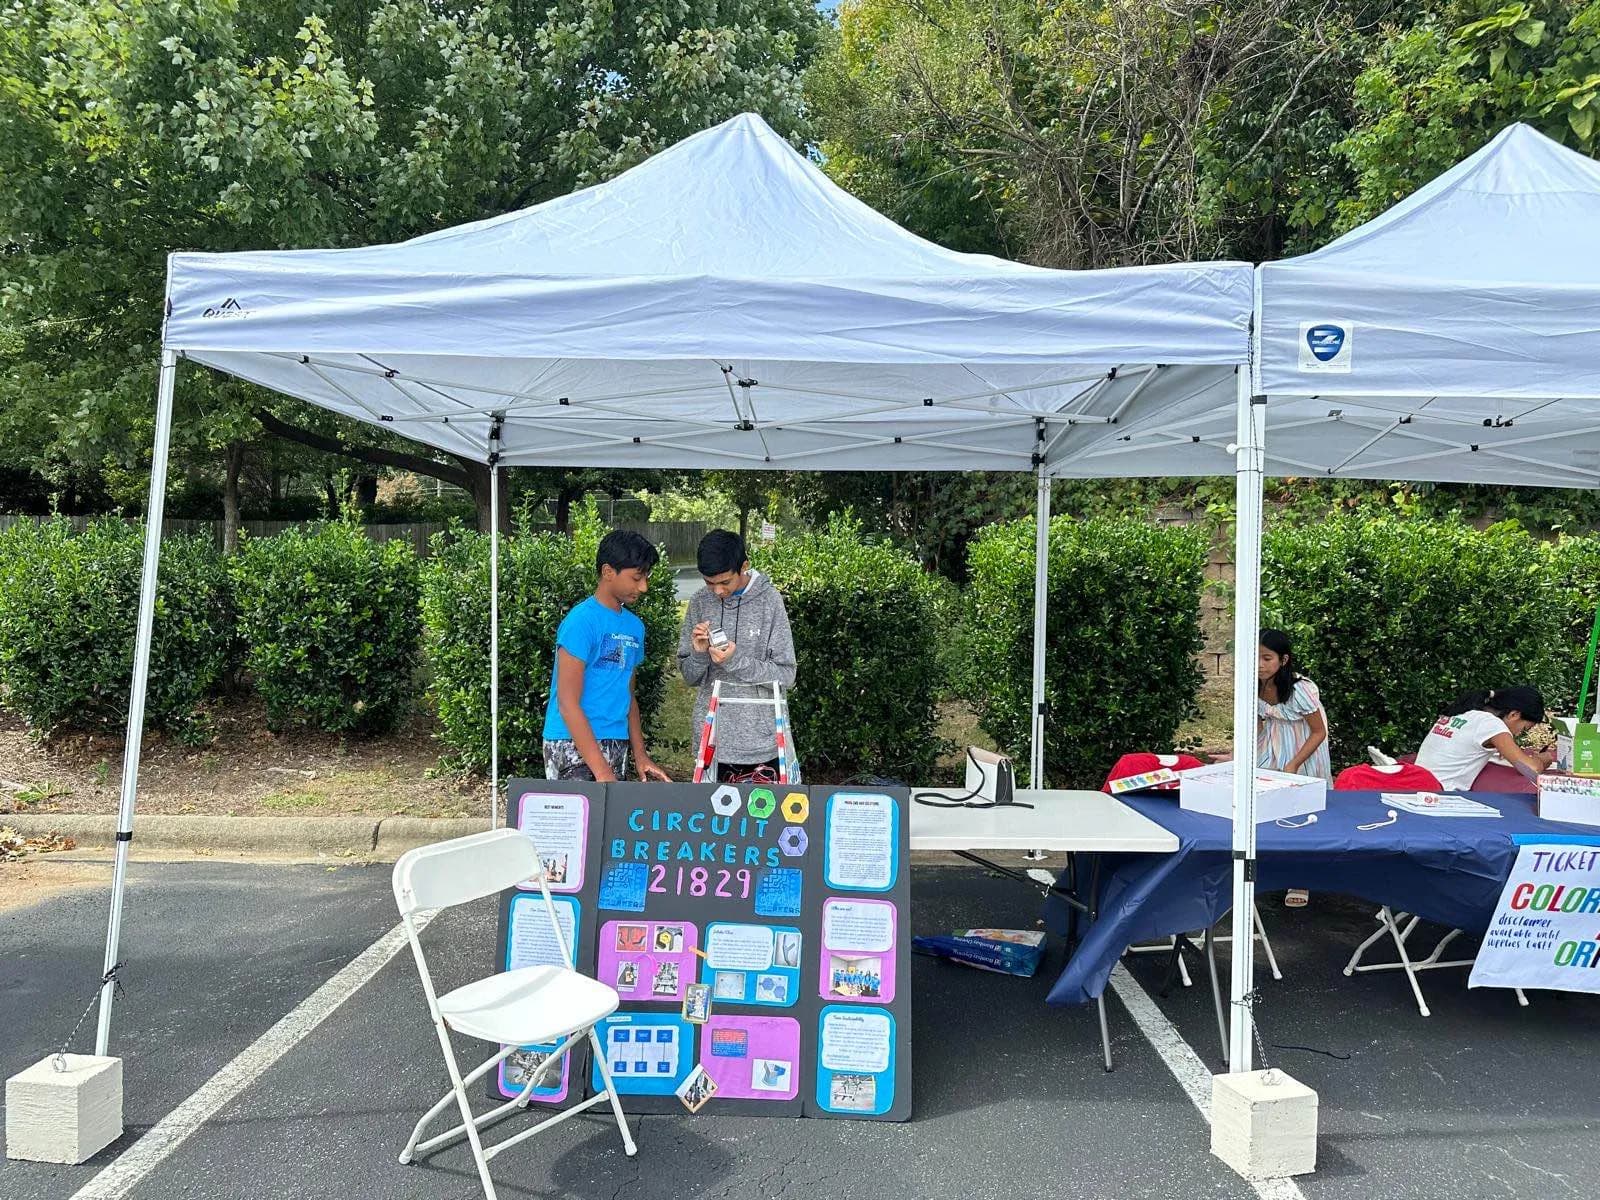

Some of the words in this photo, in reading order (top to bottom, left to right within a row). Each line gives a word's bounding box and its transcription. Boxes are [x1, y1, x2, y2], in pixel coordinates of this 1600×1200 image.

[628, 809, 769, 839] CIRCUIT
[611, 838, 780, 868] BREAKERS
[648, 864, 751, 899] 21829
[1511, 883, 1600, 914] COLOR
[1498, 912, 1553, 928] disclaimer
